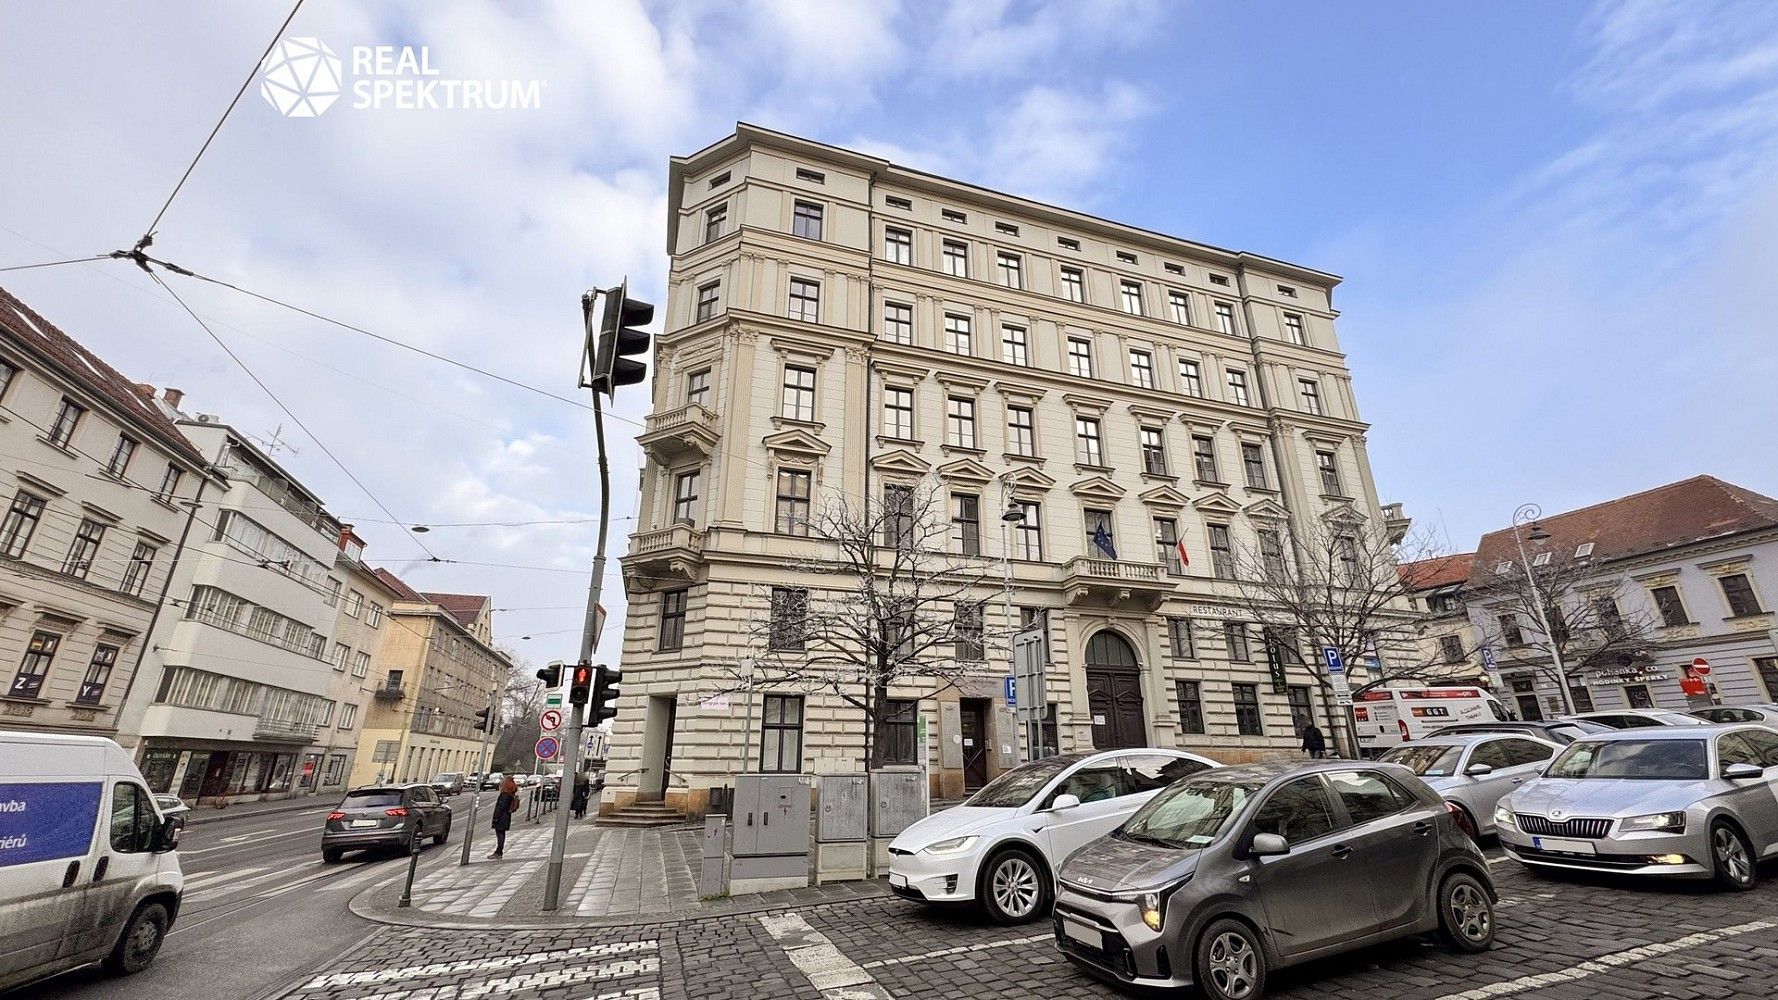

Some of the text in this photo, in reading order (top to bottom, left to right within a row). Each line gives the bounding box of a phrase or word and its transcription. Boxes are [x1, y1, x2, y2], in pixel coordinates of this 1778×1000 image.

[1192, 605, 1243, 617] RESTAURANT
[1327, 650, 1338, 665] P
[14, 677, 27, 690] Z
[1425, 708, 1445, 716] GGT
